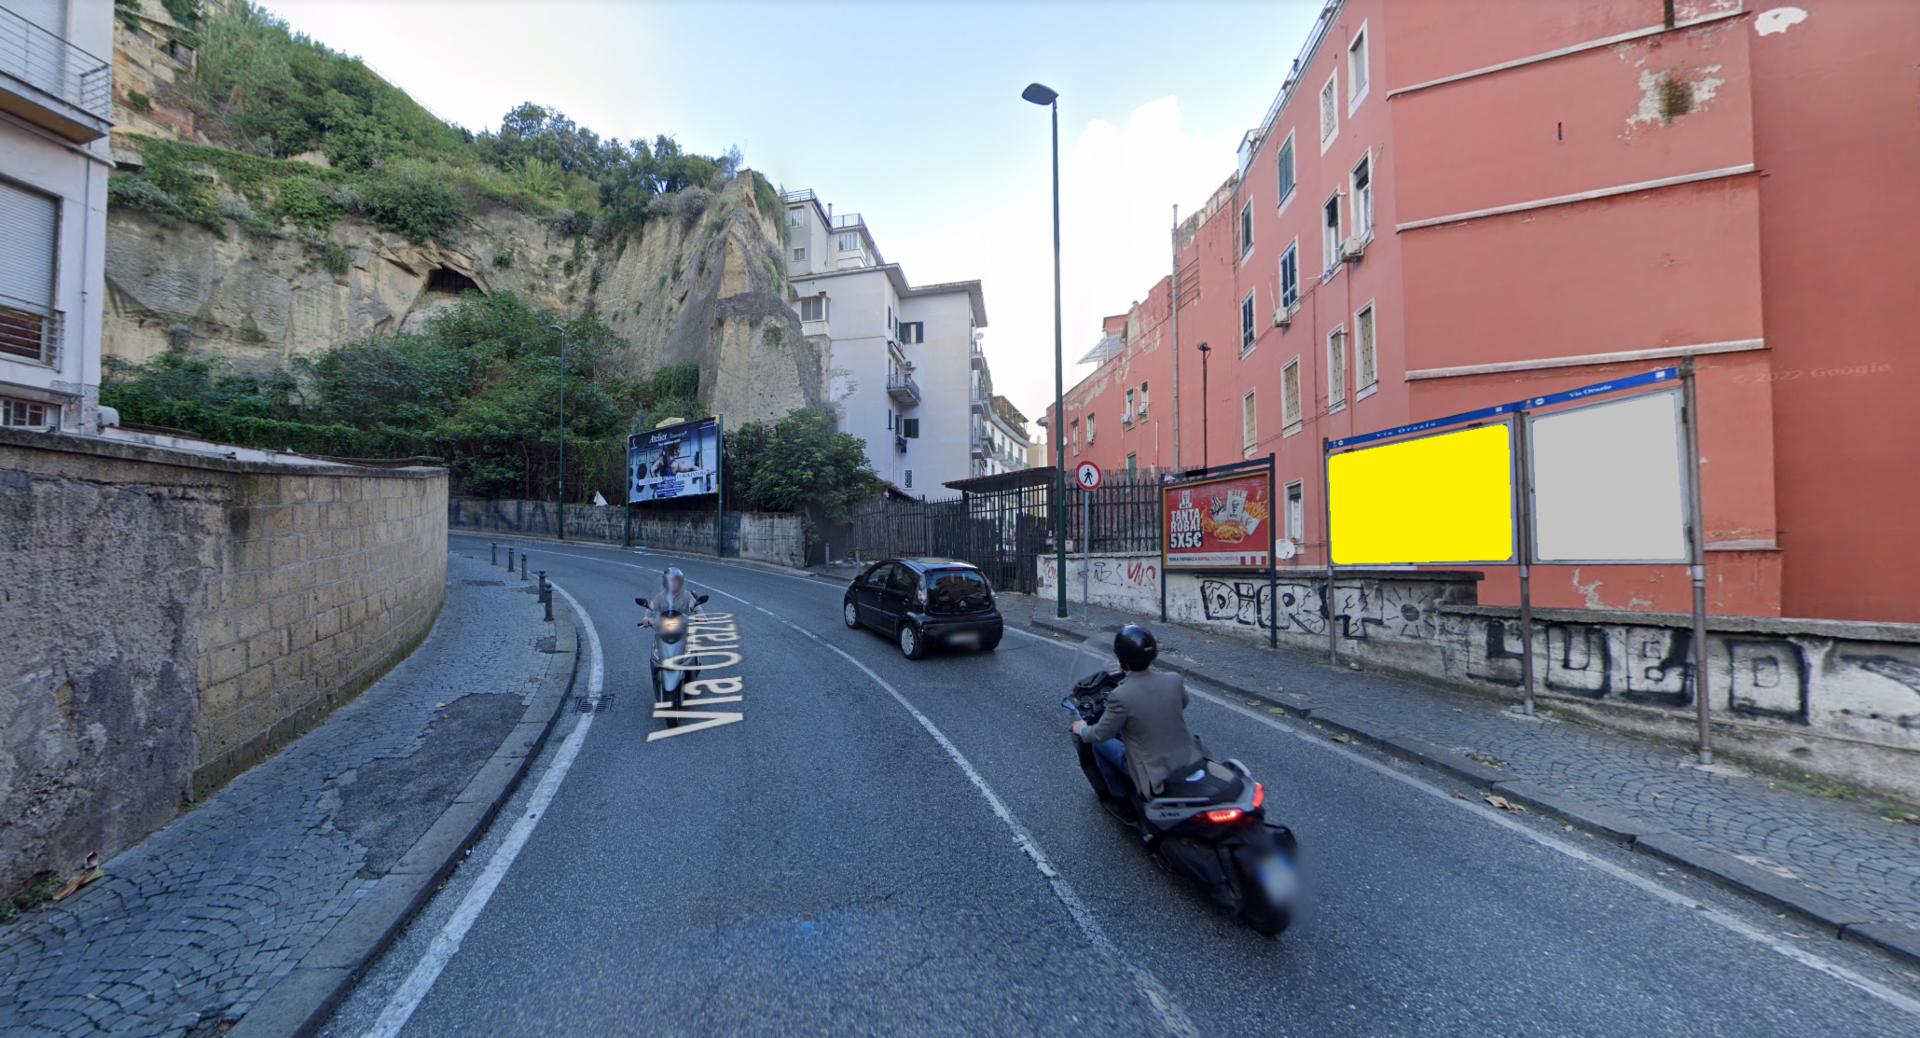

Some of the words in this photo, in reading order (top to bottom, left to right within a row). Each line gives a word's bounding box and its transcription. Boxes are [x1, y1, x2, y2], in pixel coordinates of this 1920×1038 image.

[1569, 390, 1582, 399] Via
[1583, 383, 1613, 394] Orazio
[1375, 429, 1393, 438] Via
[1170, 508, 1201, 522] TANTA
